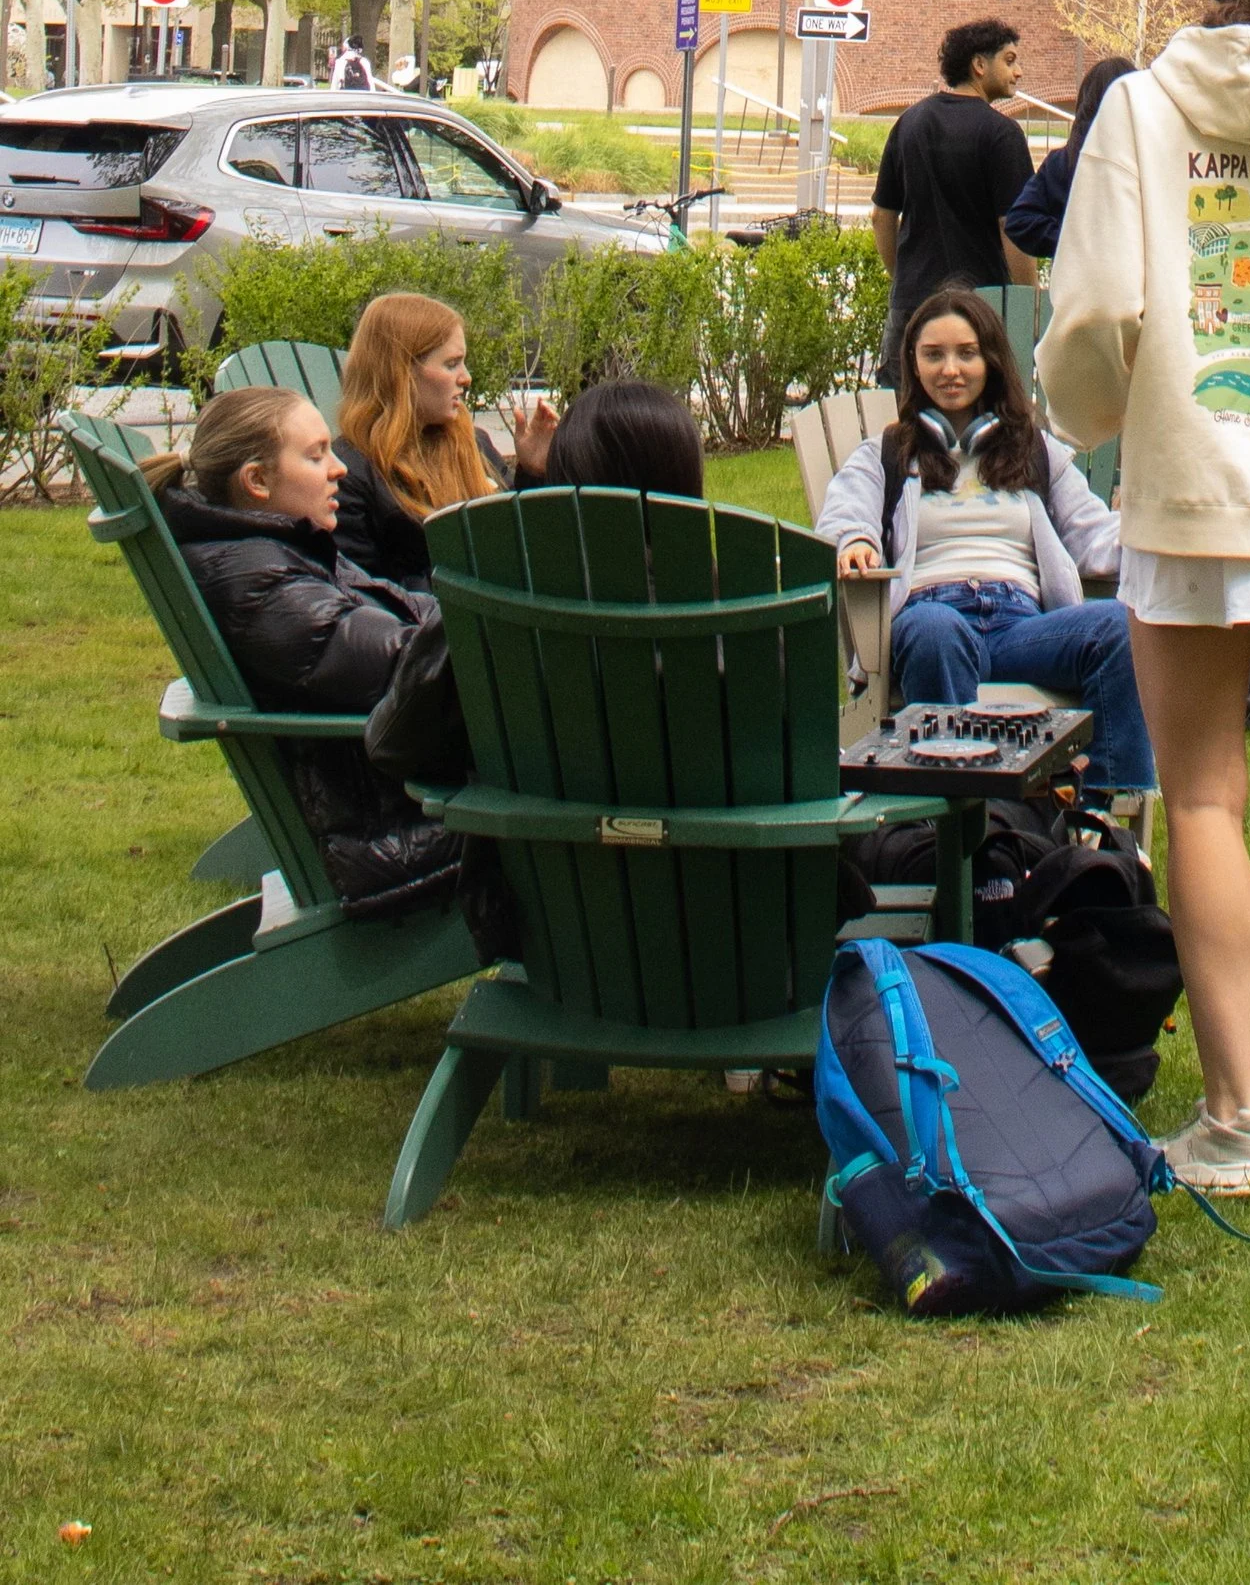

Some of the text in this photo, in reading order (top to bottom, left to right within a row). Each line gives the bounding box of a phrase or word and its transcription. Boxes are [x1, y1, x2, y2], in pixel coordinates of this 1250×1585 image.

[805, 17, 847, 31] ONE WAY
[1188, 152, 1249, 179] KAPPA
[1213, 409, 1242, 424] Home
